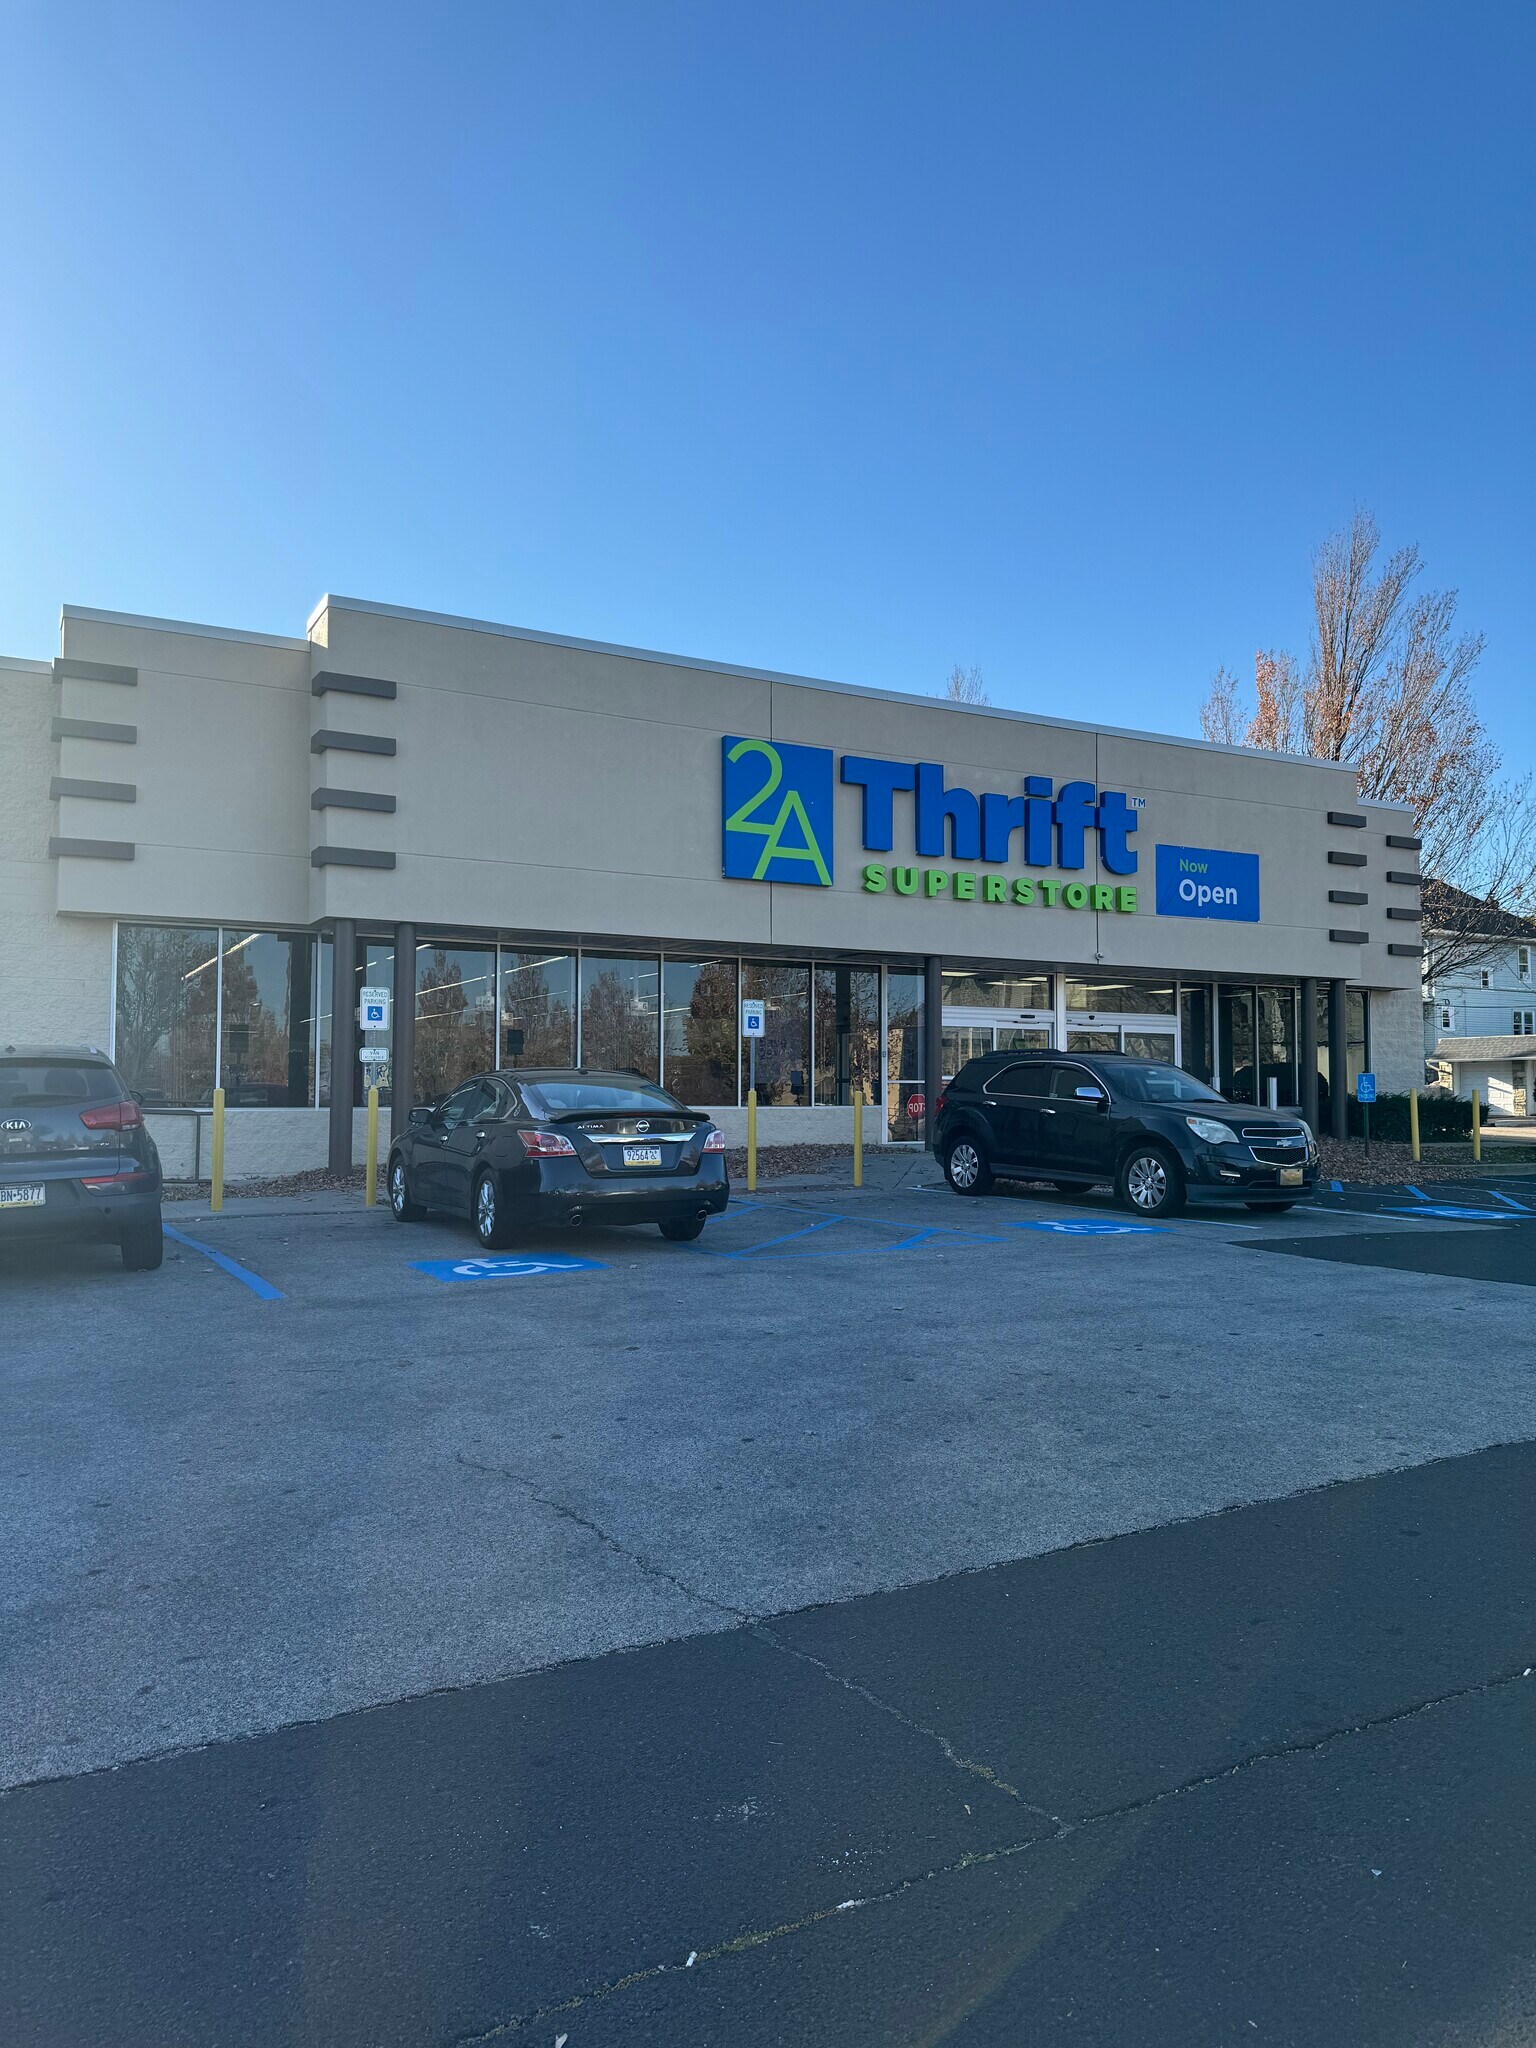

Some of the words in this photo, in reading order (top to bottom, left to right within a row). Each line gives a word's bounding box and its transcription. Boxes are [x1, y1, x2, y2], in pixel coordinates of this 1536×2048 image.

[840, 755, 1138, 876] Thrift
[1179, 858, 1208, 874] Now
[862, 863, 1138, 913] SUPERSTORE
[1179, 878, 1238, 907] Open
[6, 1121, 27, 1130] KIA
